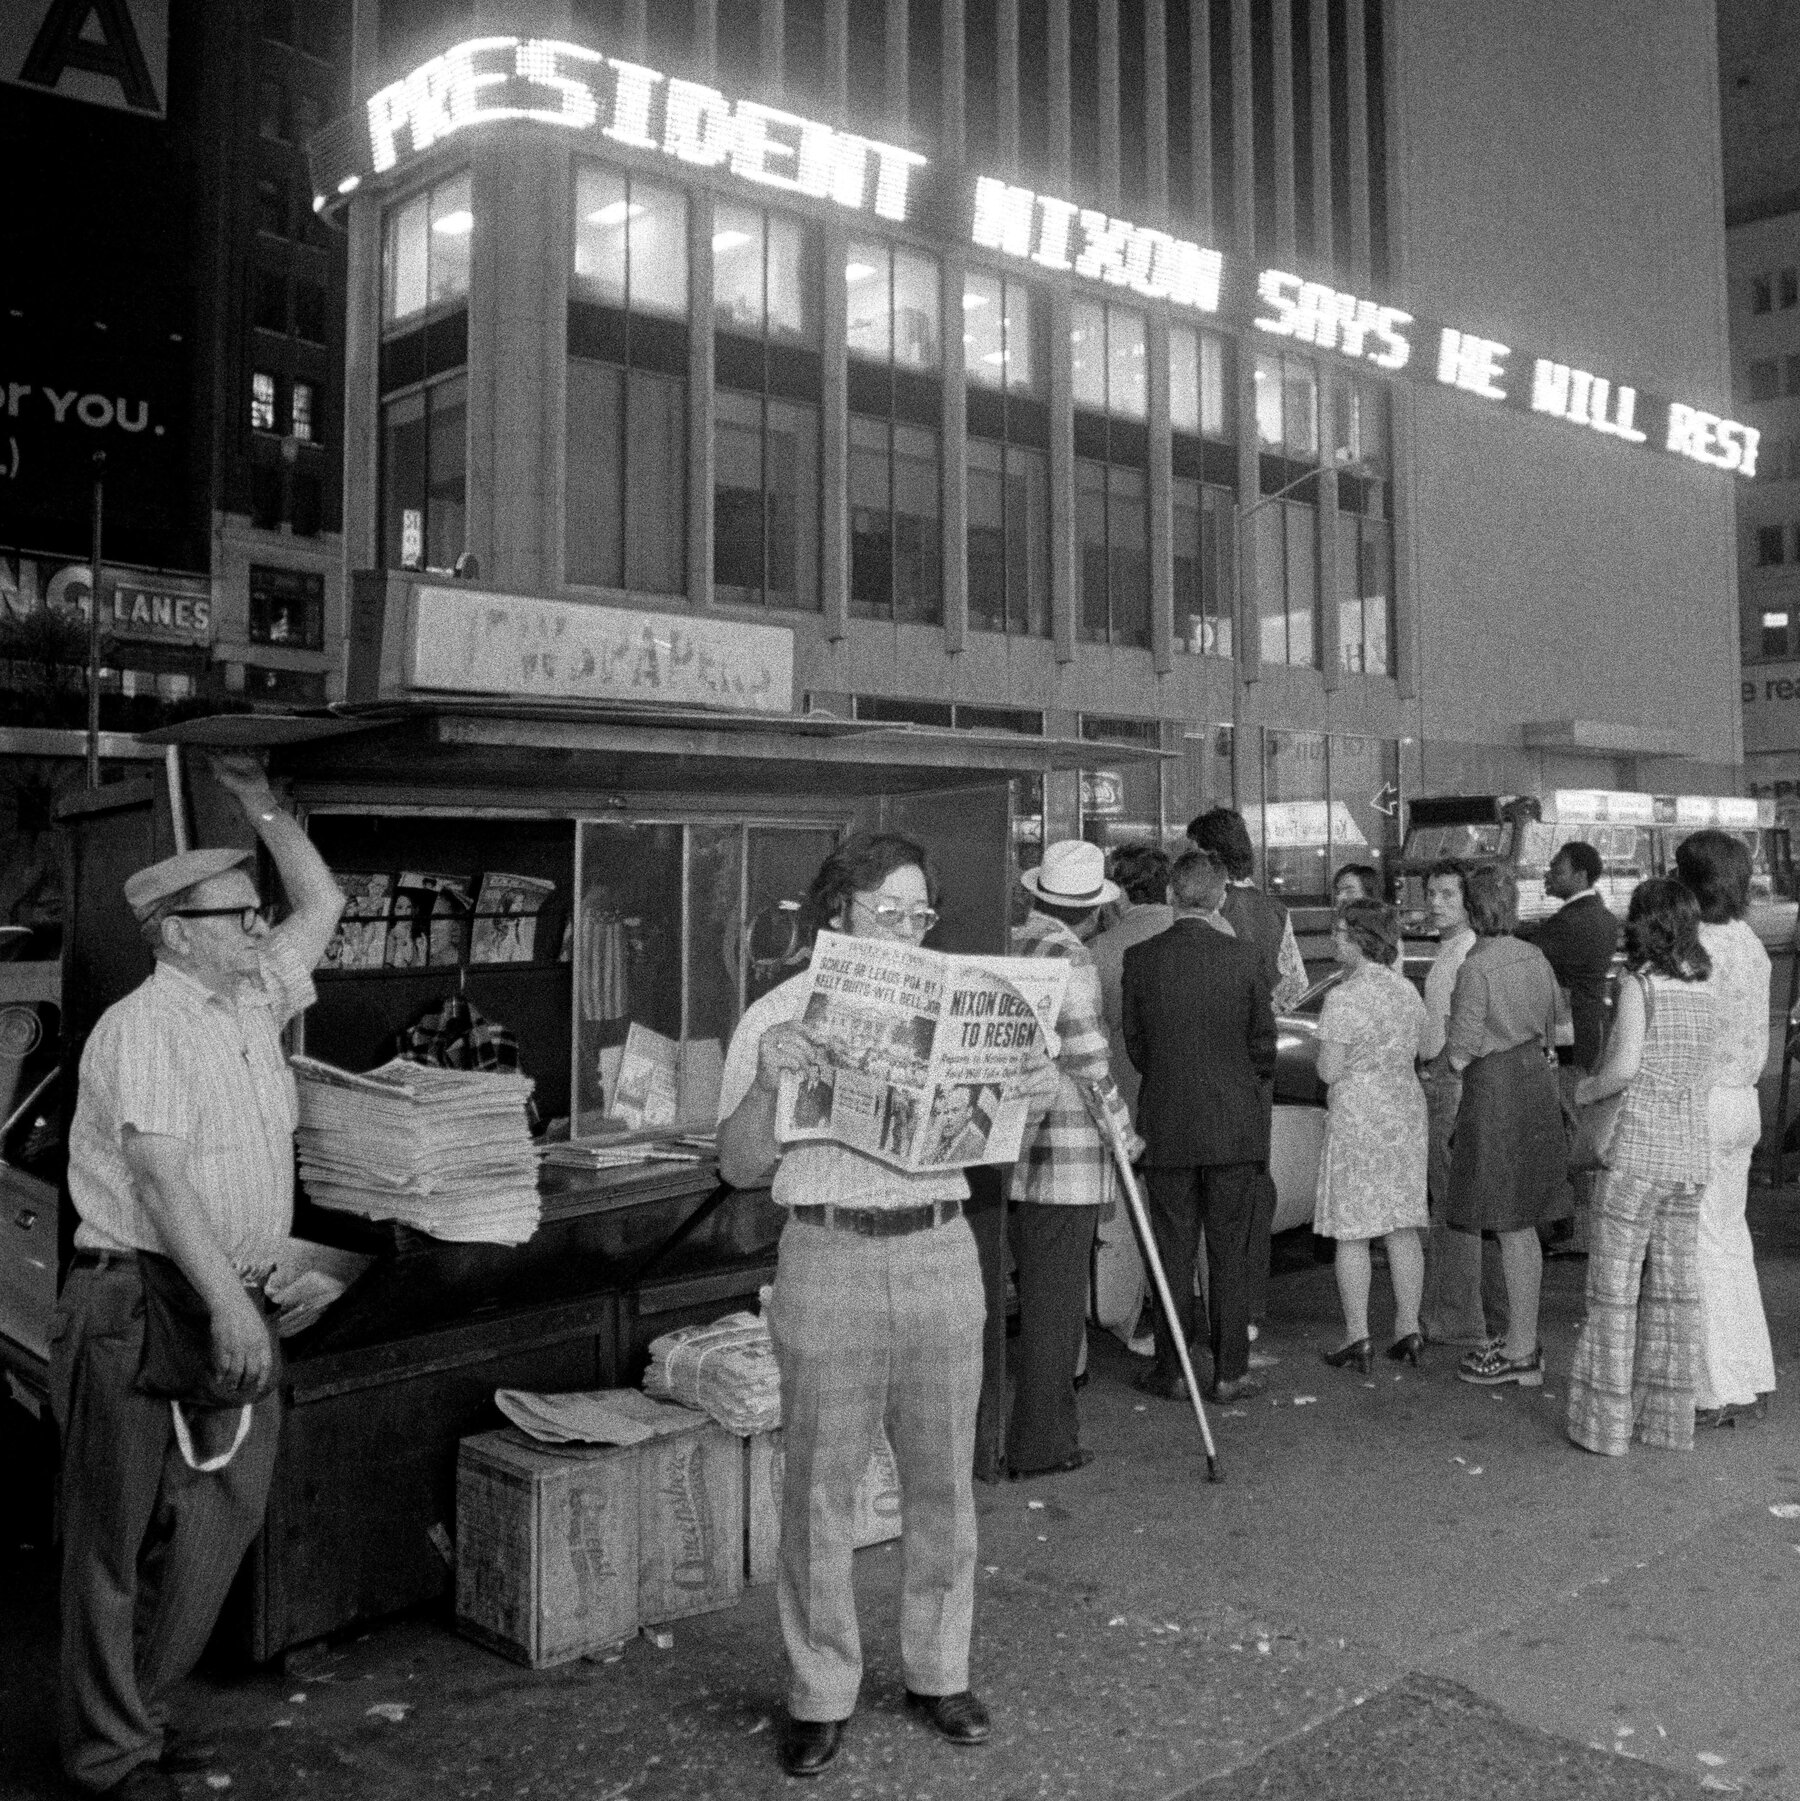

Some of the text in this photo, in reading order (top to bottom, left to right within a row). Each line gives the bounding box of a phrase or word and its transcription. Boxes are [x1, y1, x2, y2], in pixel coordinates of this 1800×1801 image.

[366, 36, 928, 221] PRESIDENT
[971, 175, 1223, 312] NIXON
[1254, 269, 1415, 369] SAYS
[1436, 327, 1512, 400] HE
[1530, 359, 1648, 443] WILL
[42, 386, 166, 437] YOU.
[113, 590, 210, 631] LANES
[949, 990, 998, 1017] NIXON
[960, 1021, 1039, 1048] TO RESIGN
